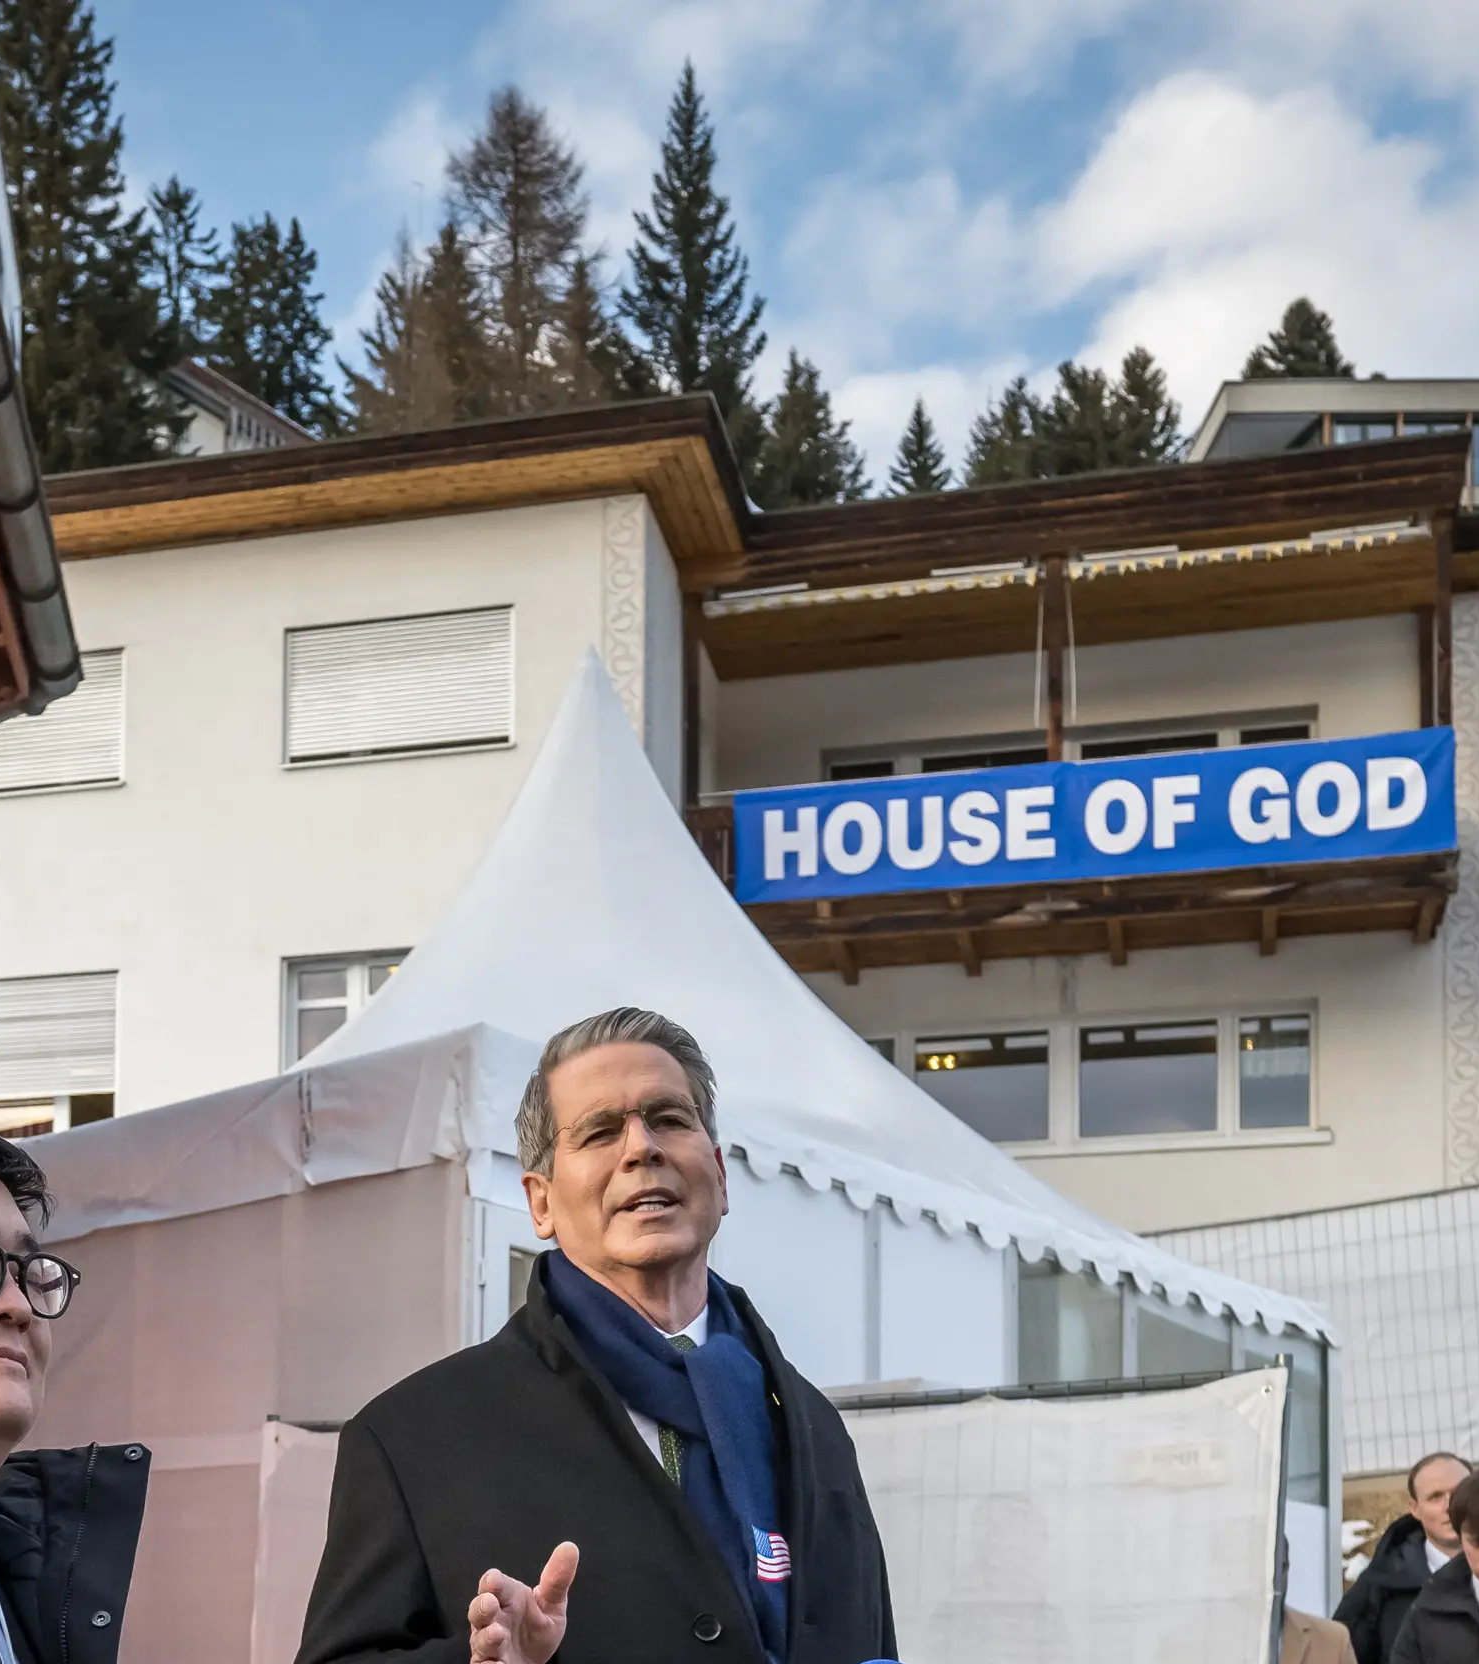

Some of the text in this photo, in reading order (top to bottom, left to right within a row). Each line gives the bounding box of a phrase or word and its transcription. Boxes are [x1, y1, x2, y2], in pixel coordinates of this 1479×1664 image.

[763, 756, 1428, 881] HOUSE OF GOD
